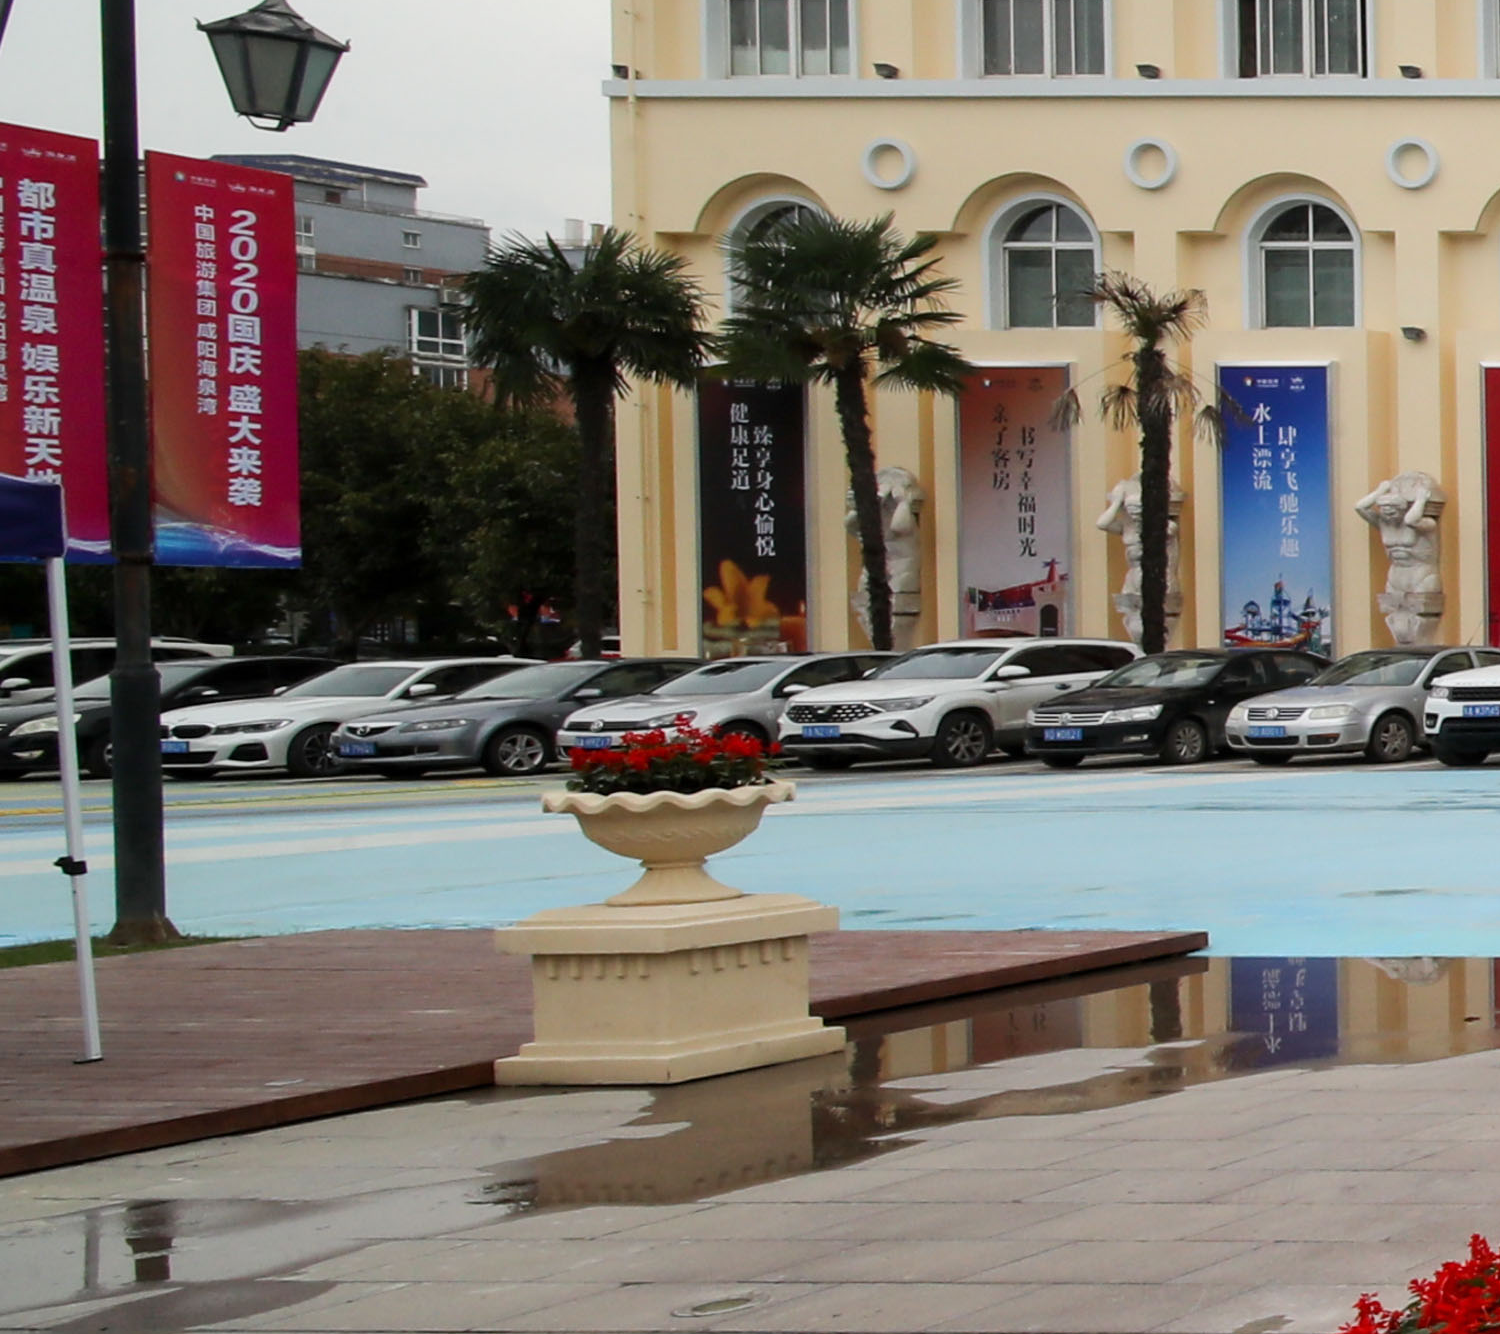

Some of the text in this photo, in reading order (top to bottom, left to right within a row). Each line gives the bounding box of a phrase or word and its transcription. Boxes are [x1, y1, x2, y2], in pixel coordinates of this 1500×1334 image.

[18, 178, 59, 335] 都市真温泉
[194, 204, 218, 416] 中国旅游集团 咸阳海泉湾
[228, 209, 263, 376] 2020国庆
[228, 384, 263, 507] 盛大来袭
[730, 402, 751, 490] 健康足道
[753, 425, 776, 557] 臻享身心愉悦
[1017, 426, 1037, 557] 书写幸福时光
[1252, 402, 1273, 490] 水上漂流
[1278, 425, 1299, 558] 肆享飞驰乐趣
